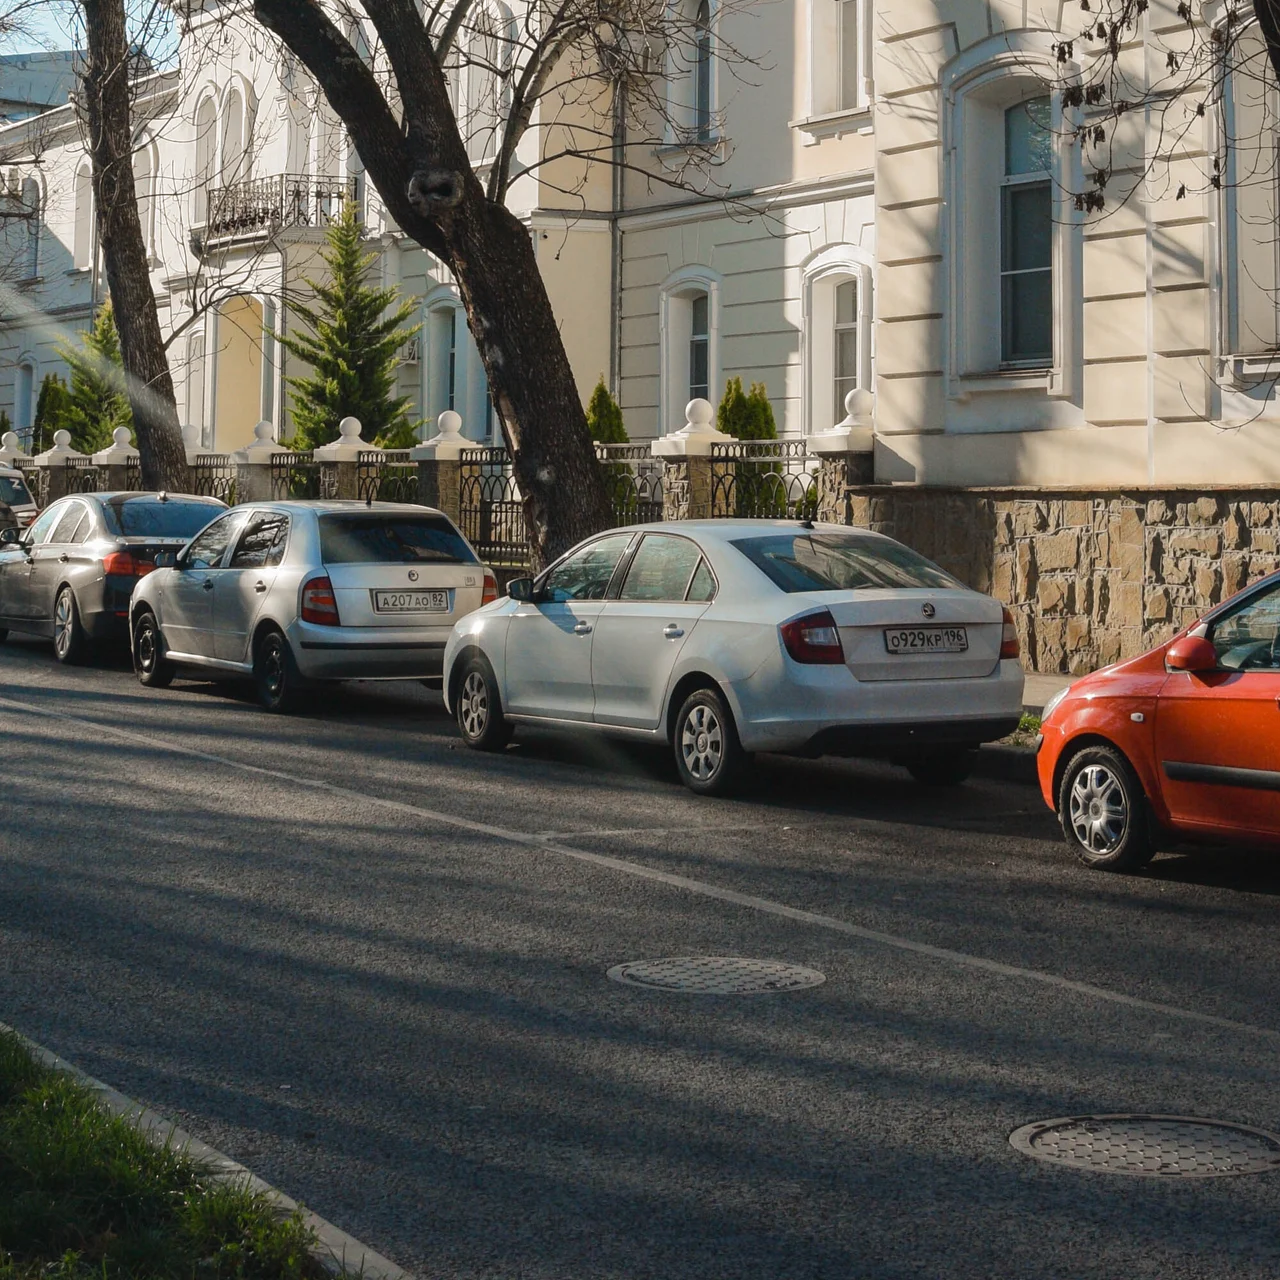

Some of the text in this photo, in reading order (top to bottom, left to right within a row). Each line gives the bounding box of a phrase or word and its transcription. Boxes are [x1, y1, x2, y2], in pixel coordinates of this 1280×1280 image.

[383, 593, 444, 607] А207АО 82
[891, 630, 963, 647] О929КР 196
